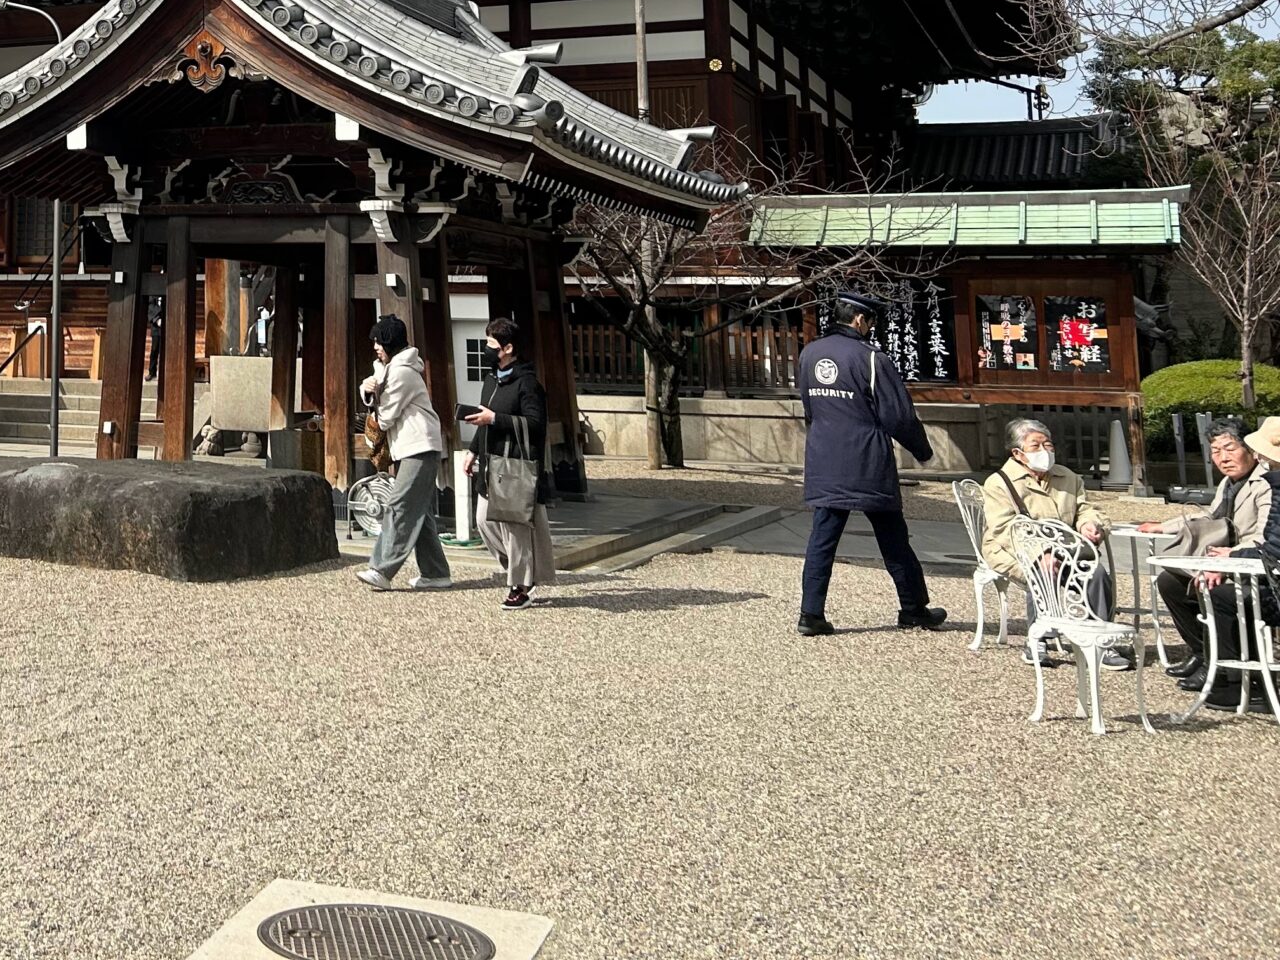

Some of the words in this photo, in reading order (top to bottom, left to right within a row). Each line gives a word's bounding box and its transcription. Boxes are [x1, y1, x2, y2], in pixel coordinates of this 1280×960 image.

[1061, 314, 1073, 358] なさいませ
[1077, 301, 1102, 362] お写経
[808, 388, 854, 399] SECURITY
